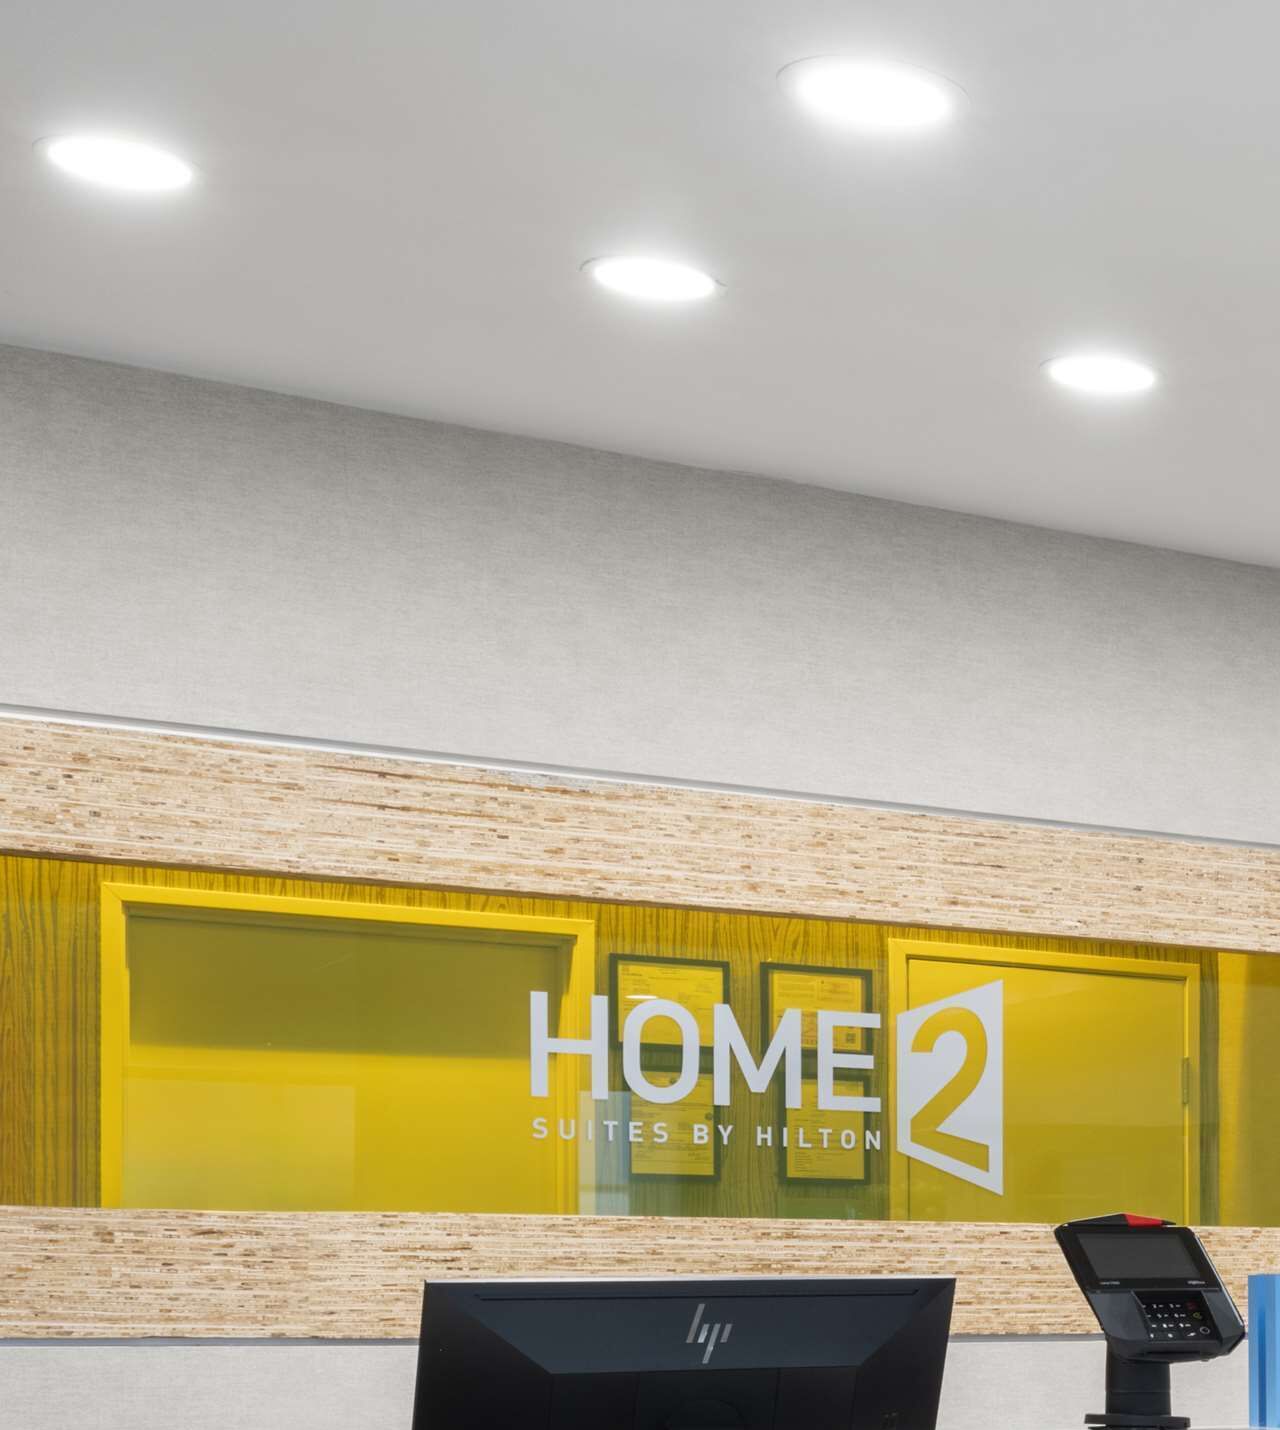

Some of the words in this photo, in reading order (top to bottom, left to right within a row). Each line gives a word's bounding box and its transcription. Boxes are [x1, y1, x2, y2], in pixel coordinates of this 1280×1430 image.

[529, 990, 882, 1113] HOME
[904, 998, 994, 1179] 2
[531, 1117, 669, 1143] SUITES
[692, 1122, 734, 1147] BY
[755, 1126, 883, 1151] HILTON
